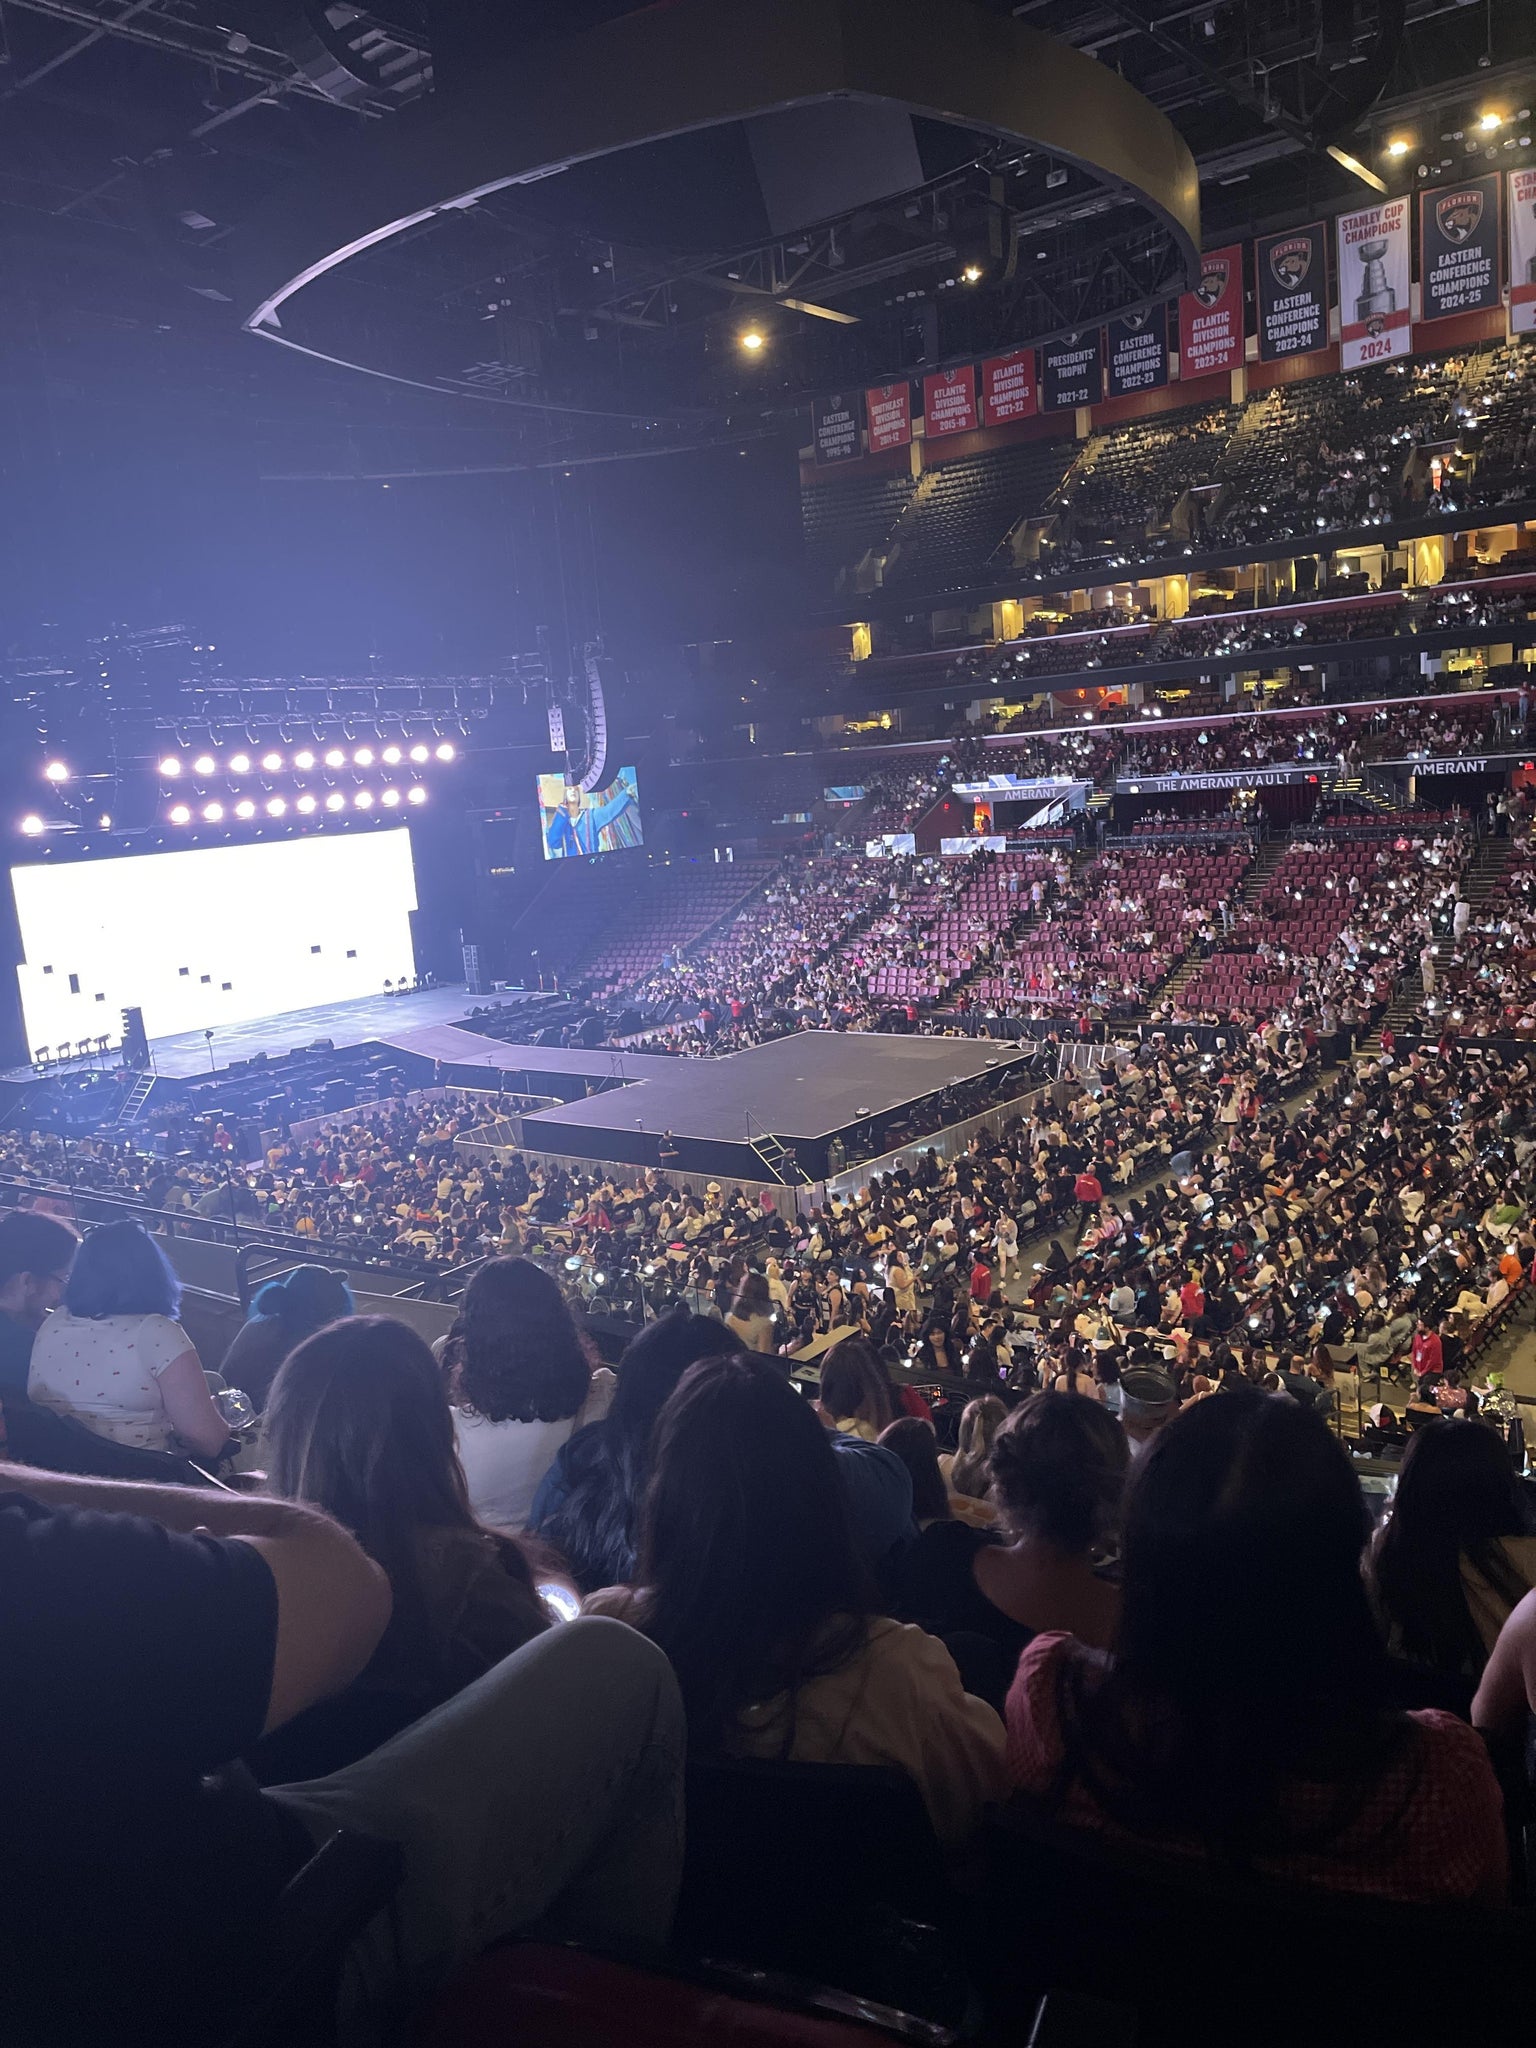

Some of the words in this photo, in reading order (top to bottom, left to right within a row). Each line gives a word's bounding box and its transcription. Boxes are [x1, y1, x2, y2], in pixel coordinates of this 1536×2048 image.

[1342, 210, 1381, 232] STANLEY
[1384, 204, 1404, 220] CUP
[1345, 218, 1401, 245] CHAMPIONS
[1438, 246, 1482, 268] EASTERN
[1430, 258, 1491, 284] CONFERENCE
[1431, 273, 1490, 297] CHAMPIONS
[1273, 291, 1312, 312] EASTERN
[1440, 289, 1481, 310] 2024-25
[1192, 311, 1230, 331] ATLANTIC
[1266, 303, 1320, 327] CONFERENCE
[1193, 324, 1229, 344] DIVISION
[1267, 318, 1319, 341] CHAMPIONS
[1120, 333, 1154, 352] EASTERN
[1187, 336, 1236, 358] CHAMPIONS
[1275, 333, 1312, 352] 2023-24
[1360, 338, 1392, 361] 2024
[1047, 347, 1096, 368] PRESIDENTS'
[1113, 344, 1162, 365] CONFERENCE
[1194, 351, 1229, 370] 2023-24
[993, 363, 1024, 381] ATLANTIC
[1057, 363, 1087, 379] TROPHY
[1115, 357, 1161, 378] CHAMPIONS
[994, 375, 1024, 393] DIVISION
[1122, 372, 1154, 389] 2022-23
[934, 383, 966, 399] ATLANTIC
[989, 386, 1029, 406] CHAMPIONS
[1057, 388, 1089, 404] 2021-22
[871, 397, 904, 416] SOUTHEAST
[935, 395, 966, 409] DIVISION
[996, 400, 1024, 417] 2021-22
[823, 411, 849, 425] EASTERN
[875, 410, 901, 425] DIVISION
[931, 404, 971, 421] CHAMPIONS
[818, 421, 855, 437] CONFERENCE
[873, 418, 905, 436] CHAMPIONS
[820, 432, 855, 448] CHAMPIONS
[1411, 760, 1488, 776] AMERANT
[1155, 781, 1177, 792] THE
[1180, 776, 1242, 790] AMERANT
[1246, 773, 1291, 786] VAULT
[1004, 788, 1057, 800] AMERANT
